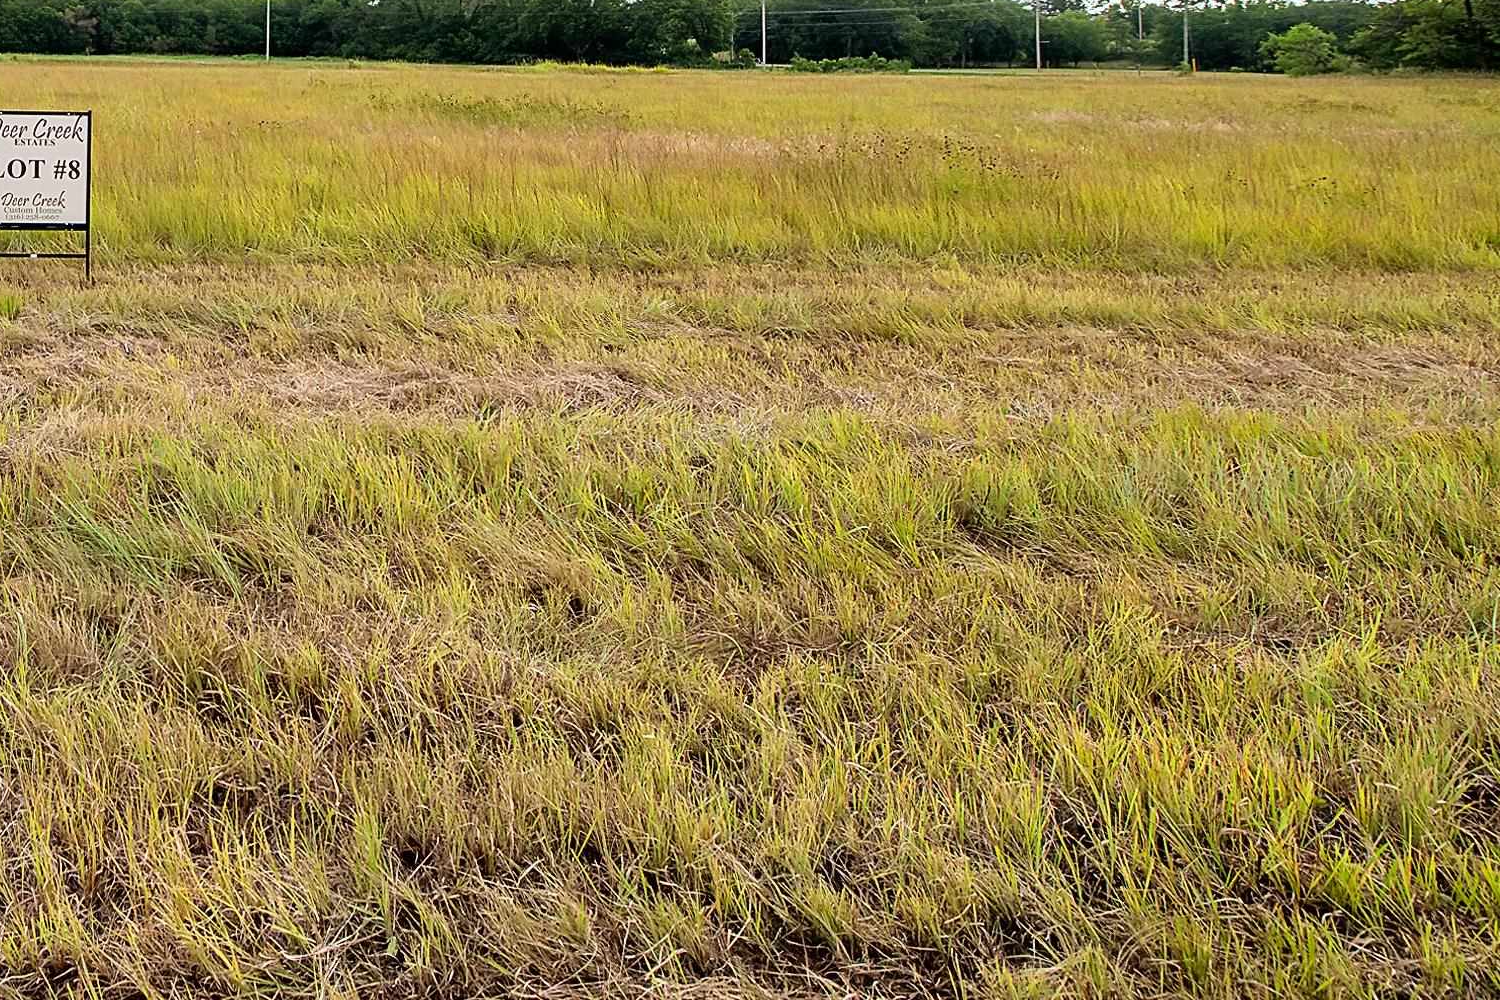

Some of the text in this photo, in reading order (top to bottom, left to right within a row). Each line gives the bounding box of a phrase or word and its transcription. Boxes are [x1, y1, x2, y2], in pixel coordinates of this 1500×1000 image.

[33, 113, 84, 142] Creek
[14, 138, 56, 146] ESTATES
[53, 159, 81, 179] #8
[1, 190, 66, 208] Deer Creek
